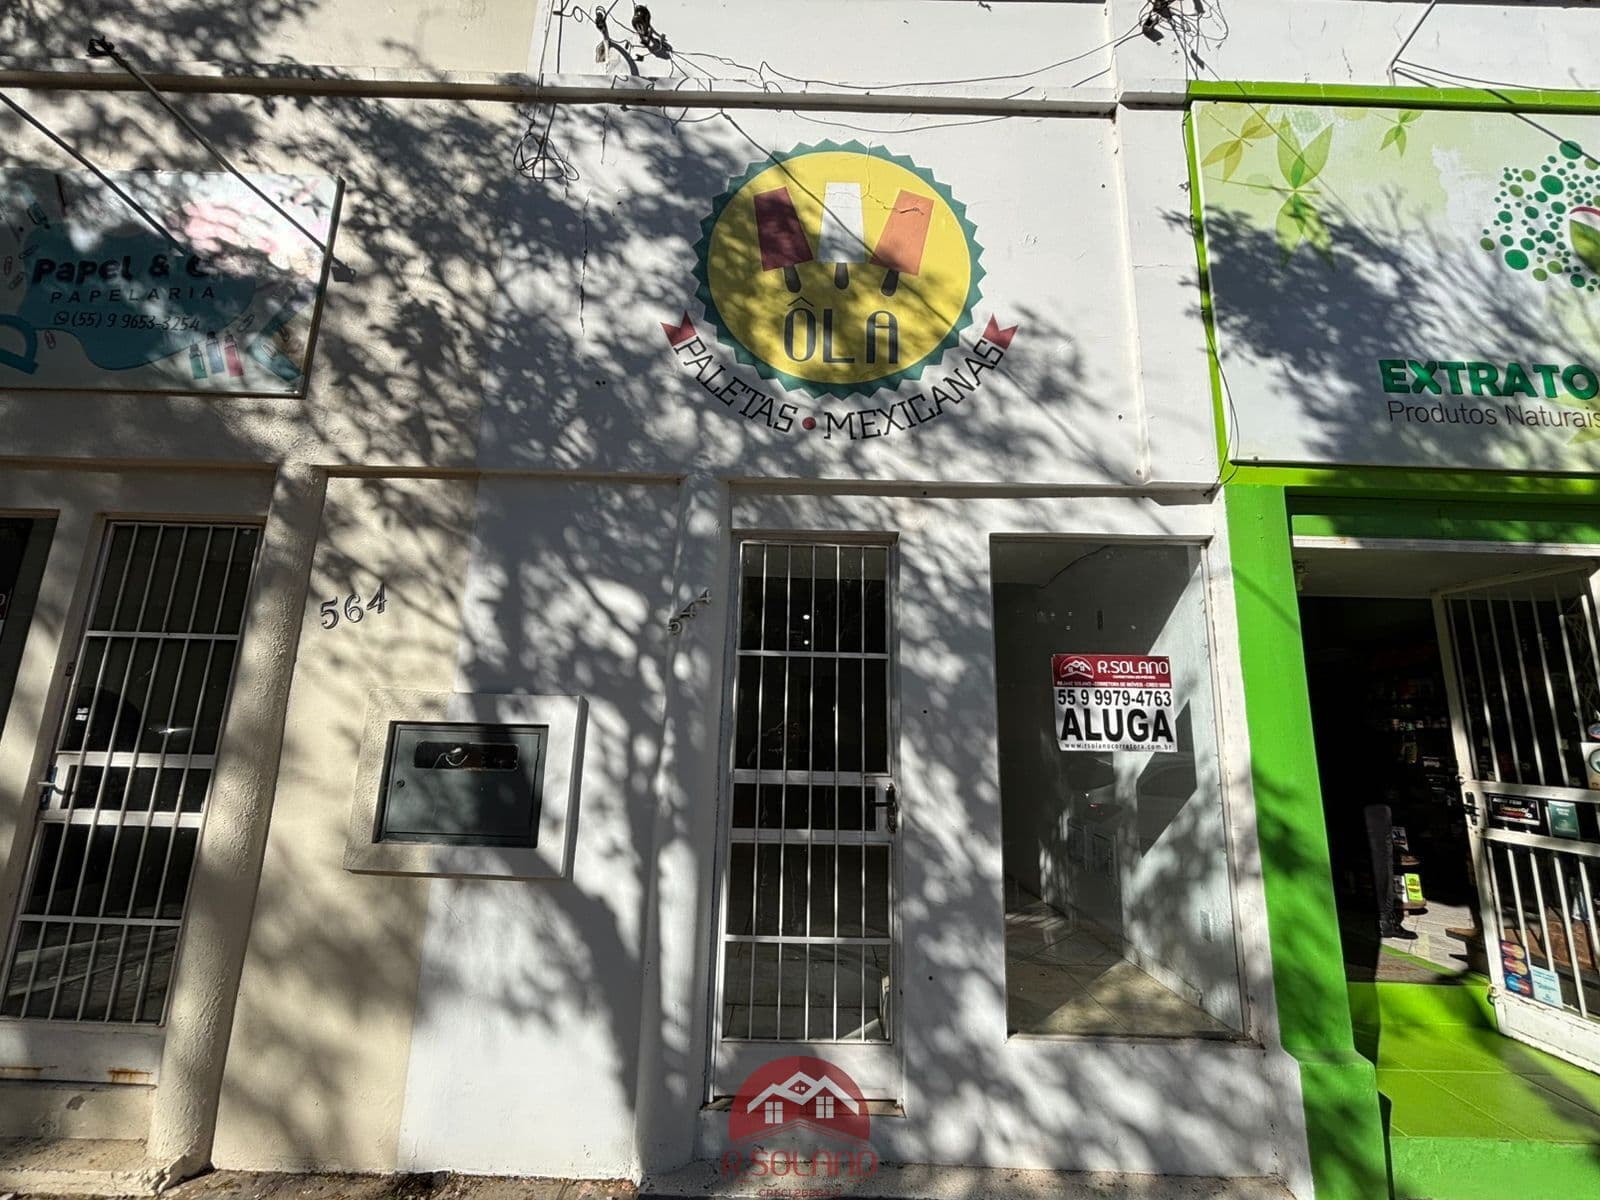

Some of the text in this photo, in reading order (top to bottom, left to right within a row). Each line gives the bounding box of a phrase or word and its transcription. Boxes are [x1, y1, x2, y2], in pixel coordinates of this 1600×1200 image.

[33, 255, 132, 284] Papel
[150, 254, 170, 277] &
[51, 286, 216, 304] PAPELARIA
[71, 312, 103, 329] (55)
[107, 313, 118, 328] 9
[784, 297, 899, 364] ÔLA
[674, 336, 1004, 440] PALETAS MEXICANAS
[1378, 359, 1599, 400] EXTRATO
[1388, 401, 1497, 425] Produtos
[320, 583, 388, 629] 564
[1097, 660, 1169, 674] R.SOLANO
[1058, 689, 1172, 707] 55 9 9979-4763
[1060, 708, 1174, 743] ALUGA
